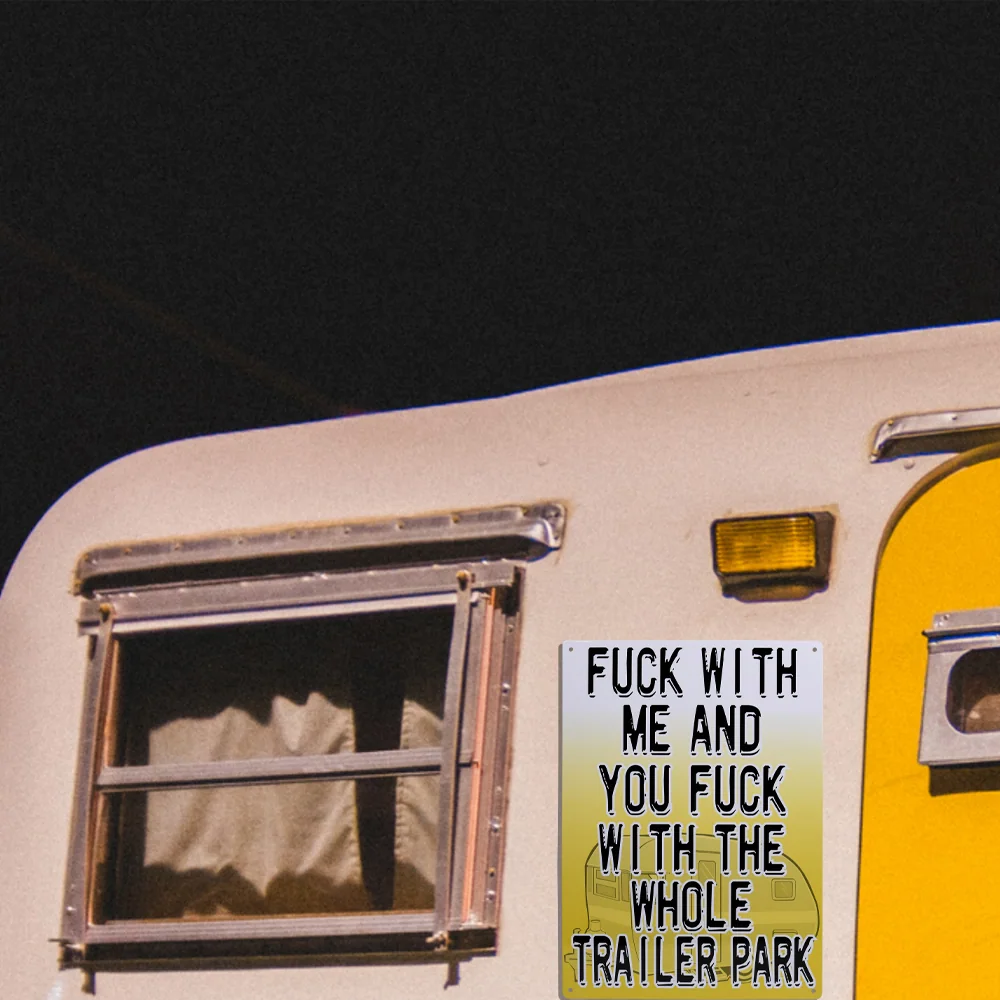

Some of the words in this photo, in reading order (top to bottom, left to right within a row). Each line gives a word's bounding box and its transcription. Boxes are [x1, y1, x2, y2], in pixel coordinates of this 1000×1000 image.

[588, 647, 684, 699] FUCK
[702, 647, 799, 699] WITH
[623, 705, 672, 757] ME
[691, 705, 762, 757] AND
[599, 765, 672, 816] YOU
[690, 765, 787, 817] FUCK
[599, 824, 696, 876] WITH
[715, 824, 786, 876] THE
[631, 881, 753, 933] WHOLE
[573, 936, 717, 988] TRAILER
[732, 936, 816, 988] PARK
